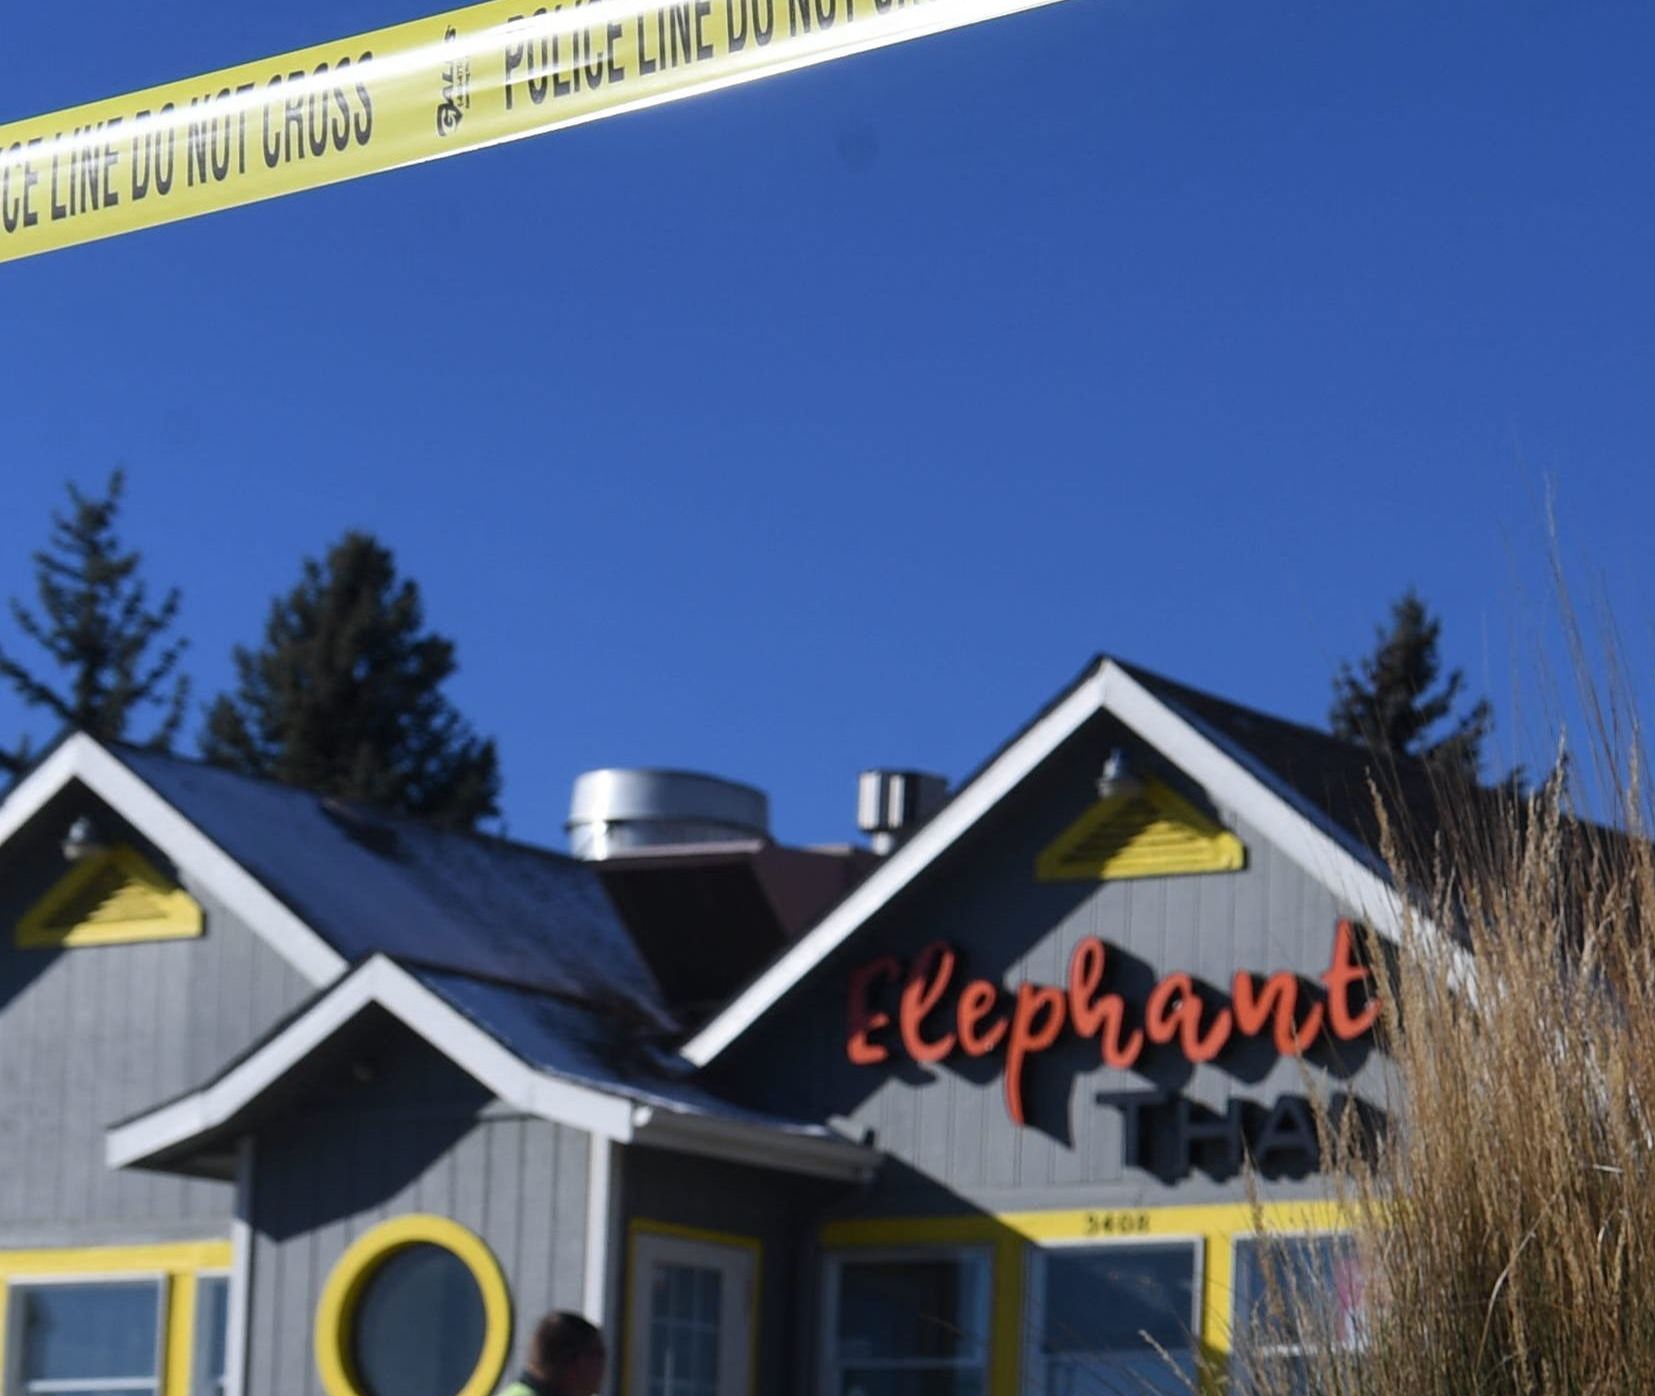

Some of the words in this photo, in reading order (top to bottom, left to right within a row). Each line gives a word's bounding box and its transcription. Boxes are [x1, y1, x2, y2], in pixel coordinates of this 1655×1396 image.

[0, 141, 42, 234] CE
[51, 117, 122, 221] LINE
[131, 102, 175, 201] DO
[187, 82, 255, 187] NOT
[262, 51, 374, 168] CROSS
[505, 0, 624, 110] POLICE
[638, 0, 714, 76] LINE
[846, 918, 1382, 1126] Elephant
